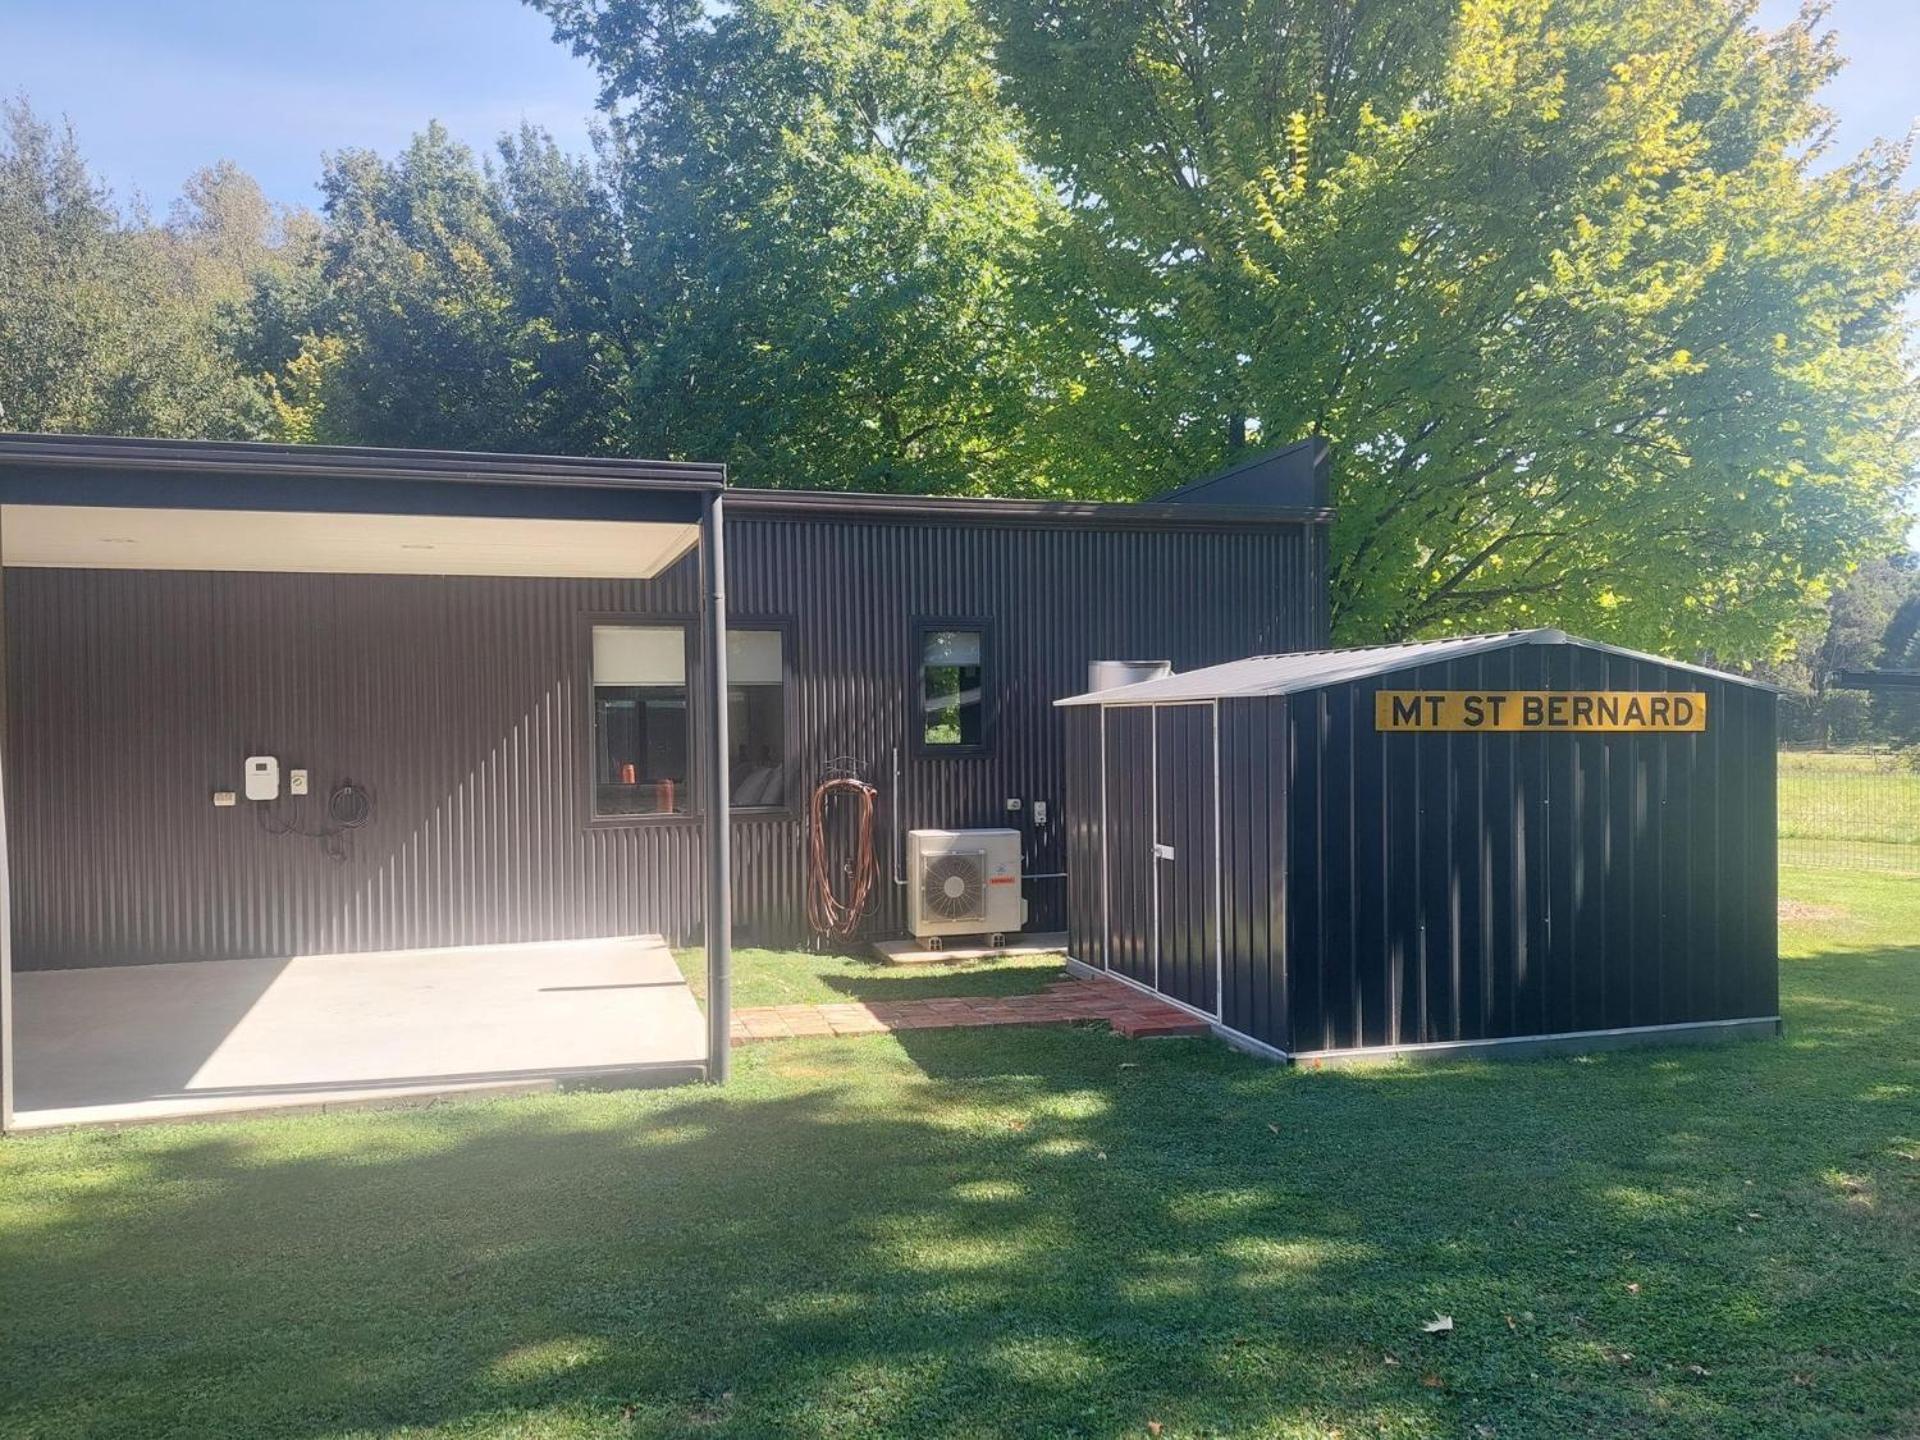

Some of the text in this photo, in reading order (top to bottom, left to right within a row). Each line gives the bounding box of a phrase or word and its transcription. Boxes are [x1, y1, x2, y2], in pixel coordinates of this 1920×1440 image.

[1393, 695, 1694, 727] MT ST BERNARD
